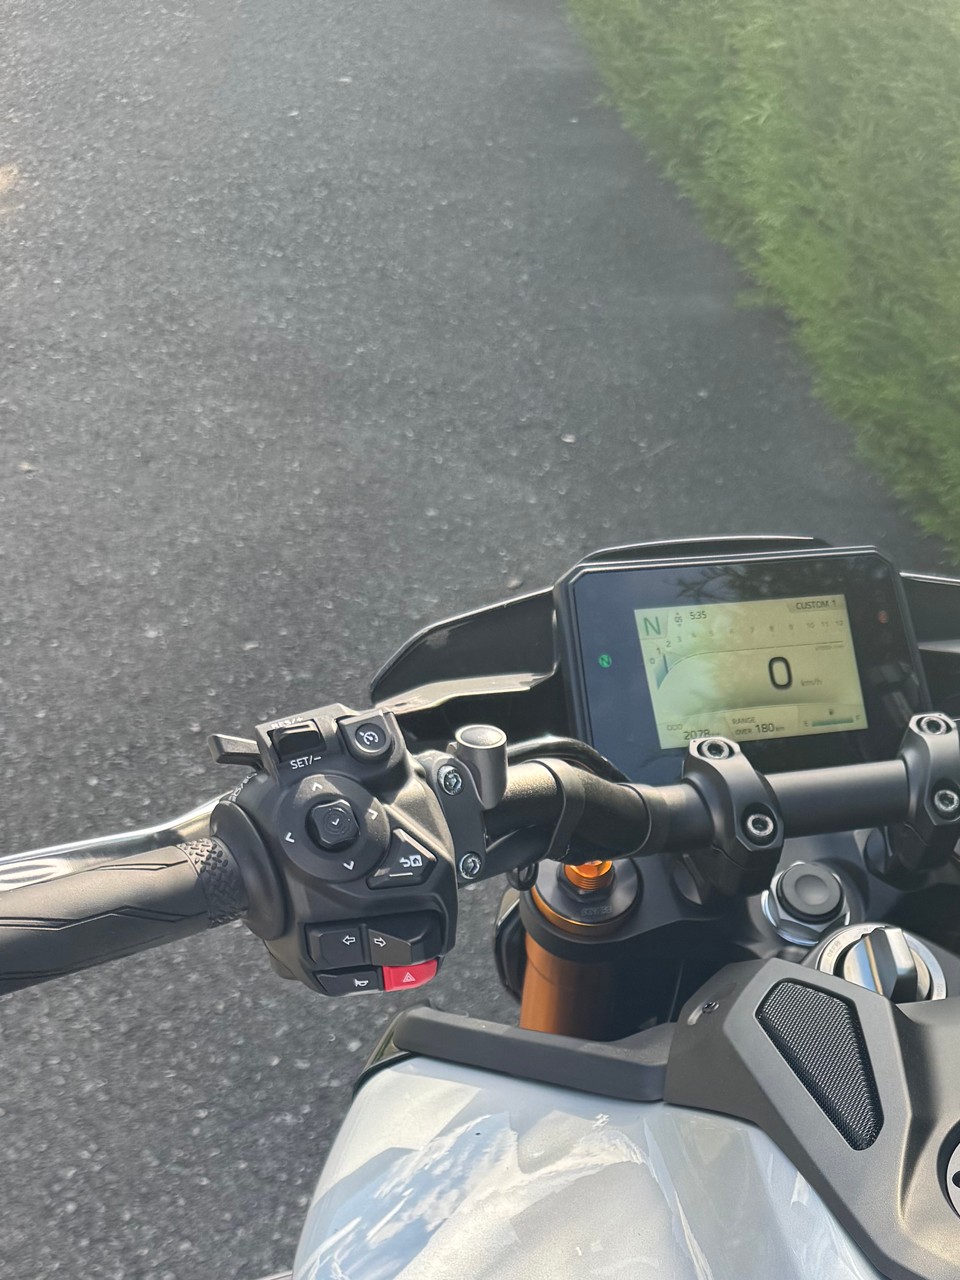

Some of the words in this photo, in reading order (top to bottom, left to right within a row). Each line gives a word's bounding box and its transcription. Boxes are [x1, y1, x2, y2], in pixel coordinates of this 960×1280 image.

[795, 599, 830, 610] CUSTOM
[643, 616, 662, 636] N
[665, 640, 672, 648] 2
[768, 656, 793, 690] 0
[732, 716, 756, 724] RANGE
[755, 723, 775, 734] 180
[683, 729, 710, 740] 2078
[290, 755, 322, 770] SET/-
